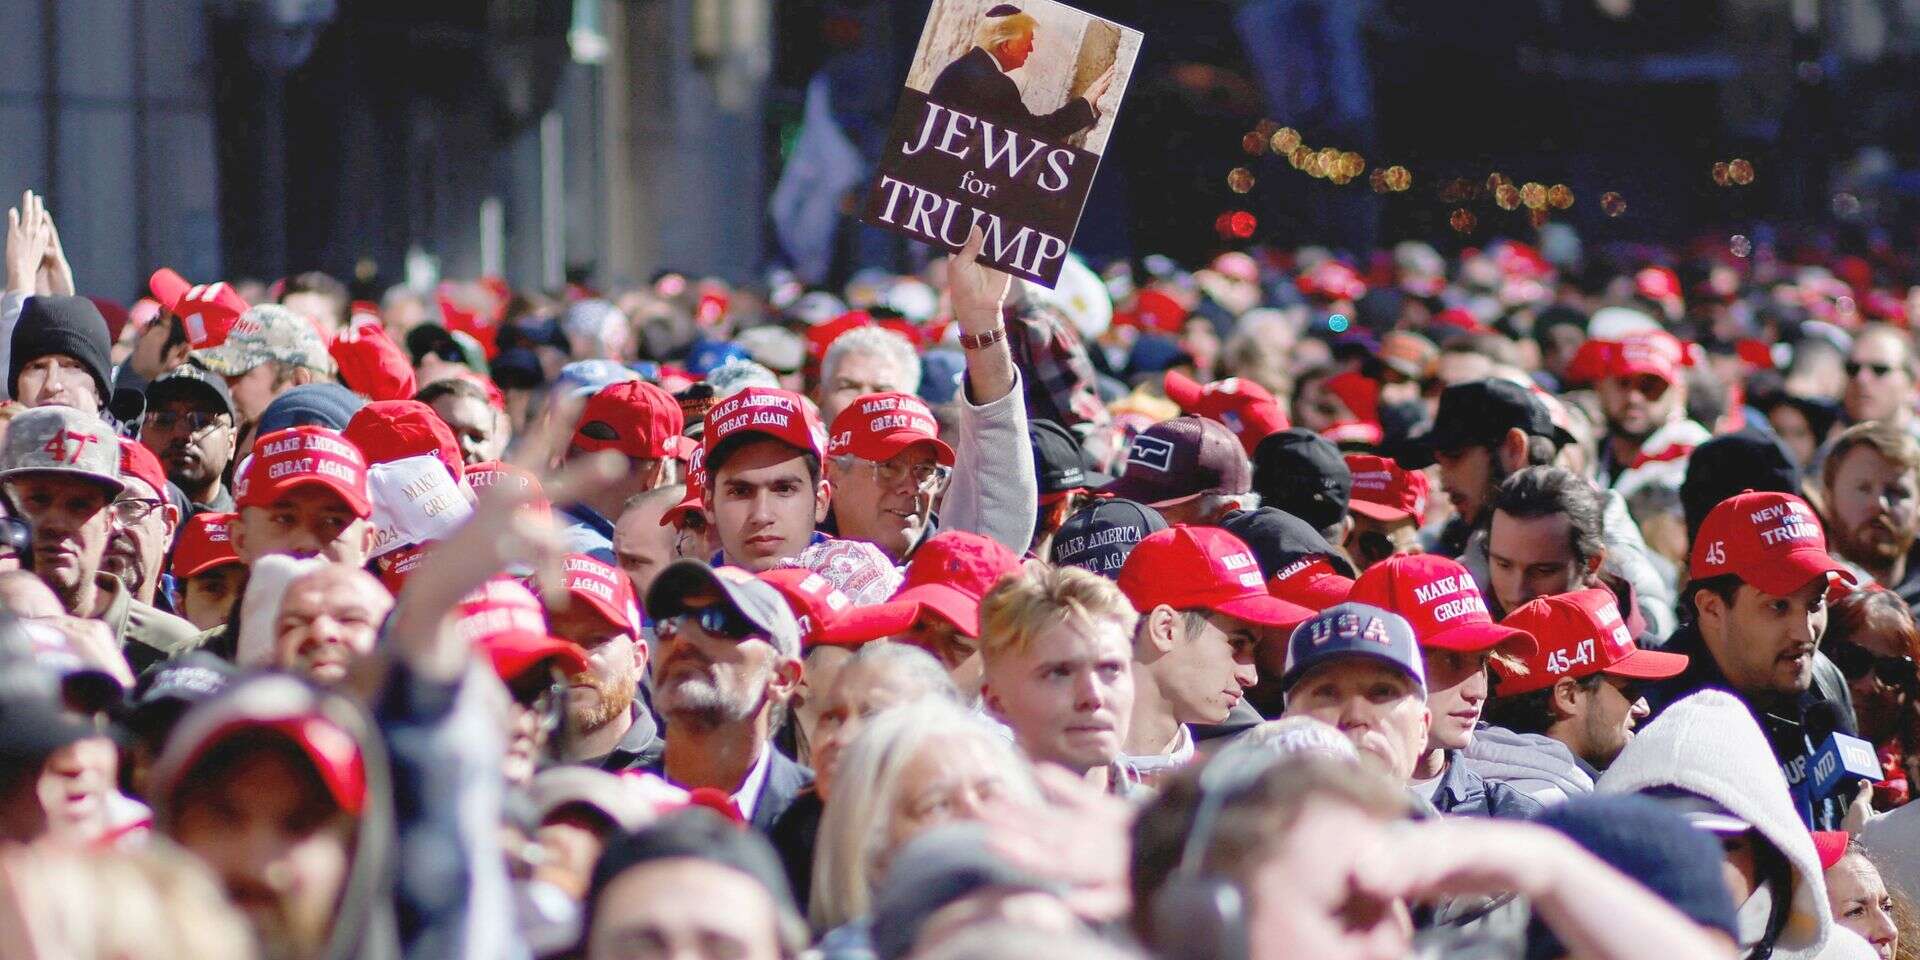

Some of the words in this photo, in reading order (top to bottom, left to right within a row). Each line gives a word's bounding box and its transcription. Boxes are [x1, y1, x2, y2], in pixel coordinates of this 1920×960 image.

[902, 101, 1076, 192] JEWS
[959, 170, 996, 199] for
[878, 174, 1066, 277] TRUMP
[711, 400, 739, 425] MAKE
[741, 395, 794, 413] AMERICA
[862, 398, 897, 414] MAKE
[718, 414, 749, 437] GREAT
[752, 412, 788, 427] AGAIN
[871, 415, 908, 432] GREAT
[43, 427, 98, 464] 47
[263, 437, 301, 458] MAKE
[269, 458, 313, 479] GREAT
[1751, 504, 1784, 524] NEW
[1057, 537, 1085, 560] MAKE
[1087, 525, 1142, 549] AMERICA
[1705, 541, 1726, 565] 45
[1414, 577, 1456, 604] MAKE
[1434, 600, 1476, 623] GREAT
[1310, 613, 1392, 647] USA
[1547, 638, 1595, 674] 45-47
[1813, 750, 1836, 787] NTD
